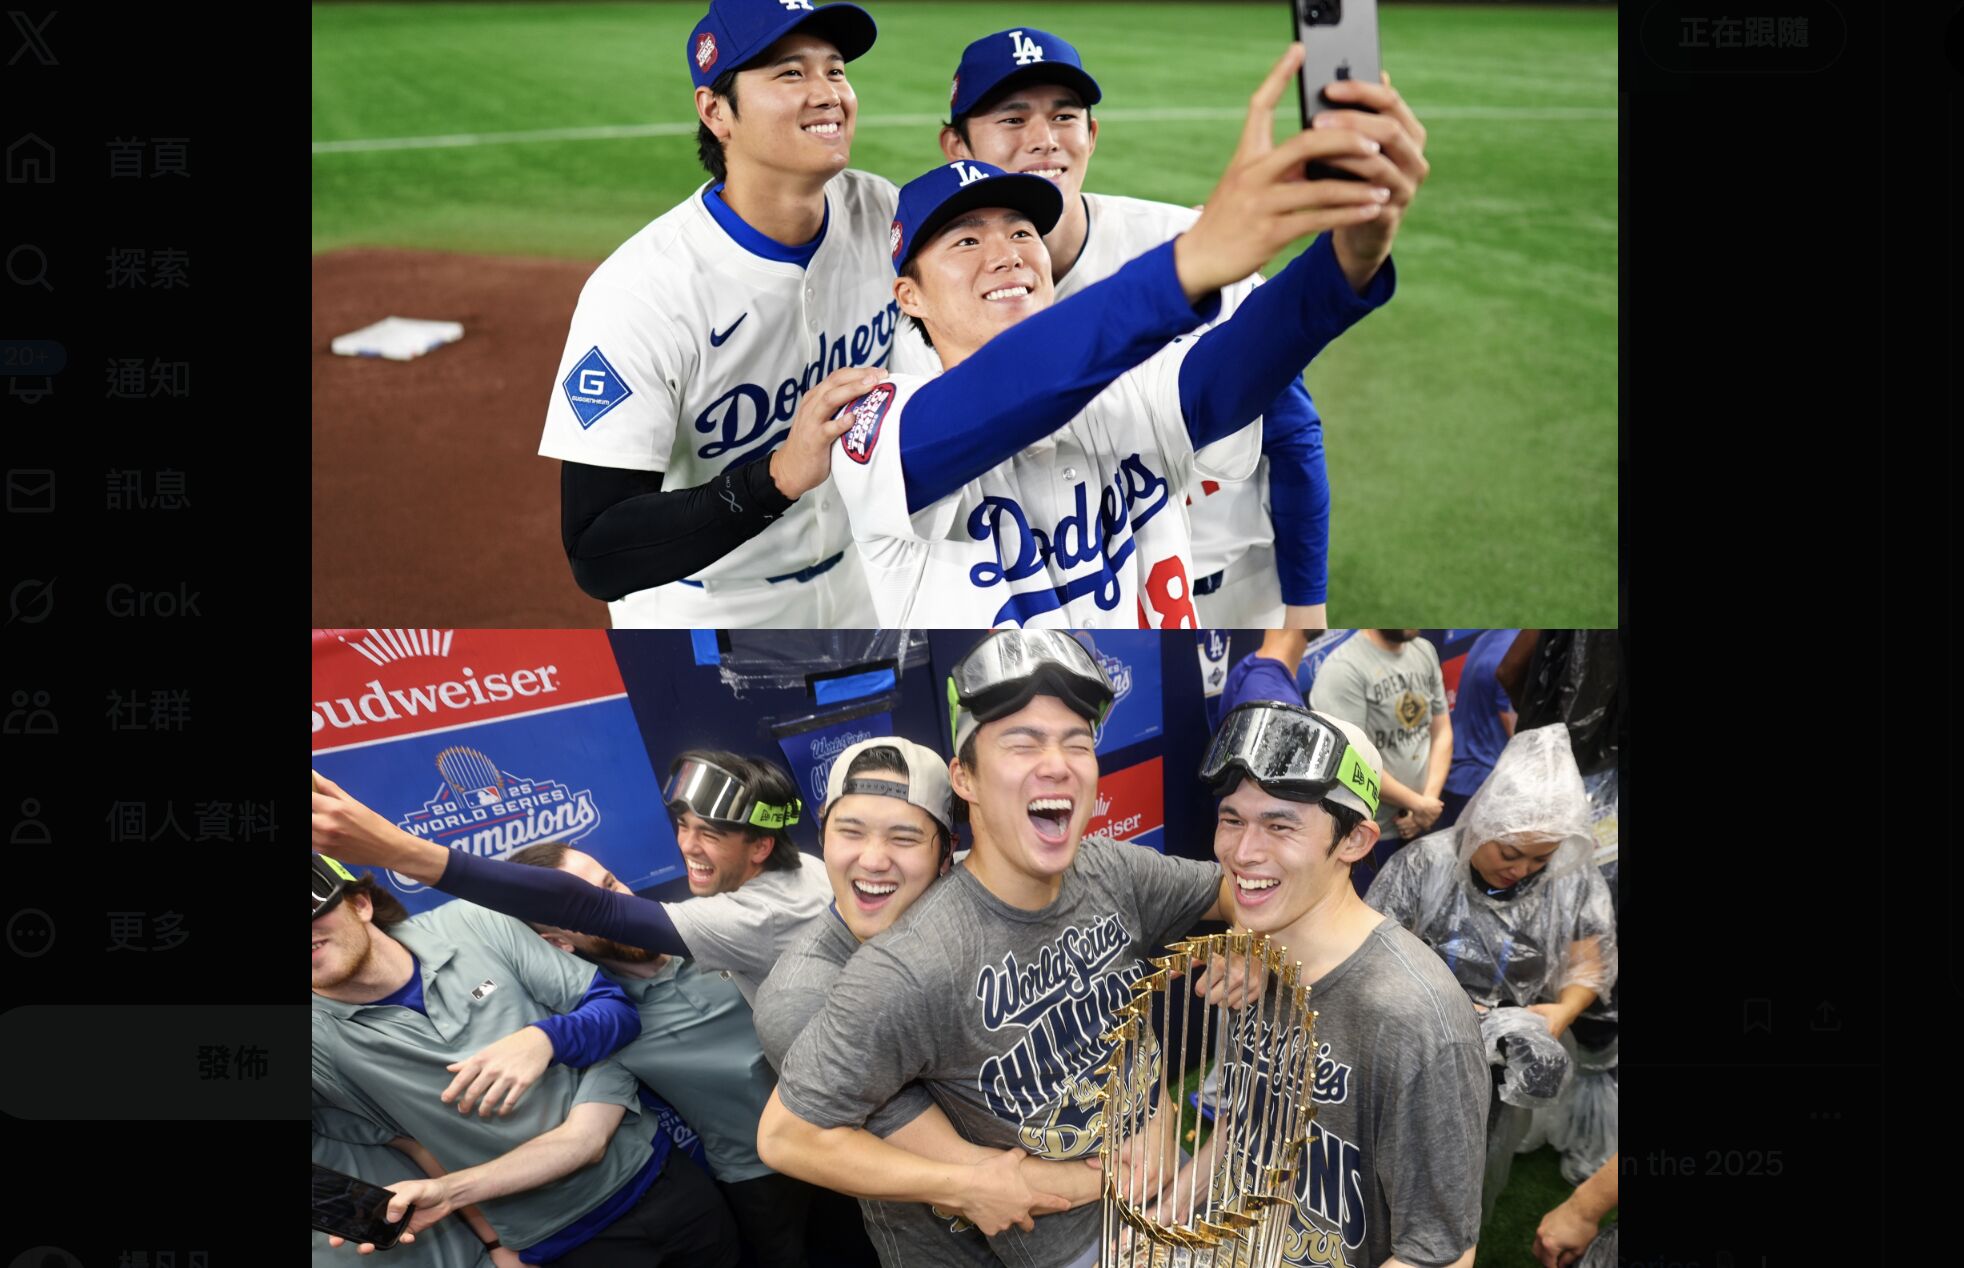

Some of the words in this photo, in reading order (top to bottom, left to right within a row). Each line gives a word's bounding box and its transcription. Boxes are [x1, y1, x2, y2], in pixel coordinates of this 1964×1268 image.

[1009, 29, 1044, 65] LA
[1678, 16, 1809, 49] 正在跟隨
[105, 136, 191, 179] 首頁
[949, 161, 990, 187] LA
[105, 246, 190, 290] 探索
[4, 347, 49, 366] 20+
[105, 356, 190, 400] 通知
[579, 369, 606, 396] G
[105, 467, 192, 510] 訊息
[105, 581, 202, 618] Grok
[1138, 555, 1201, 629] 8
[105, 689, 192, 732] 社群
[312, 663, 559, 733] udweiser
[105, 799, 280, 843] 個人資料
[407, 808, 488, 837] WORLD
[493, 789, 565, 815] SERIES
[430, 801, 457, 816] 20
[508, 784, 532, 798] 25
[446, 795, 596, 859] ampions
[1082, 813, 1142, 841] weiser
[105, 909, 190, 953] 更多
[976, 944, 1071, 1031] World
[1062, 912, 1131, 1000] Series
[196, 1044, 269, 1081] 發佈
[978, 960, 1149, 1124] CHAMPIO
[1646, 1148, 1697, 1177] the
[1704, 1149, 1784, 1177] 2025
